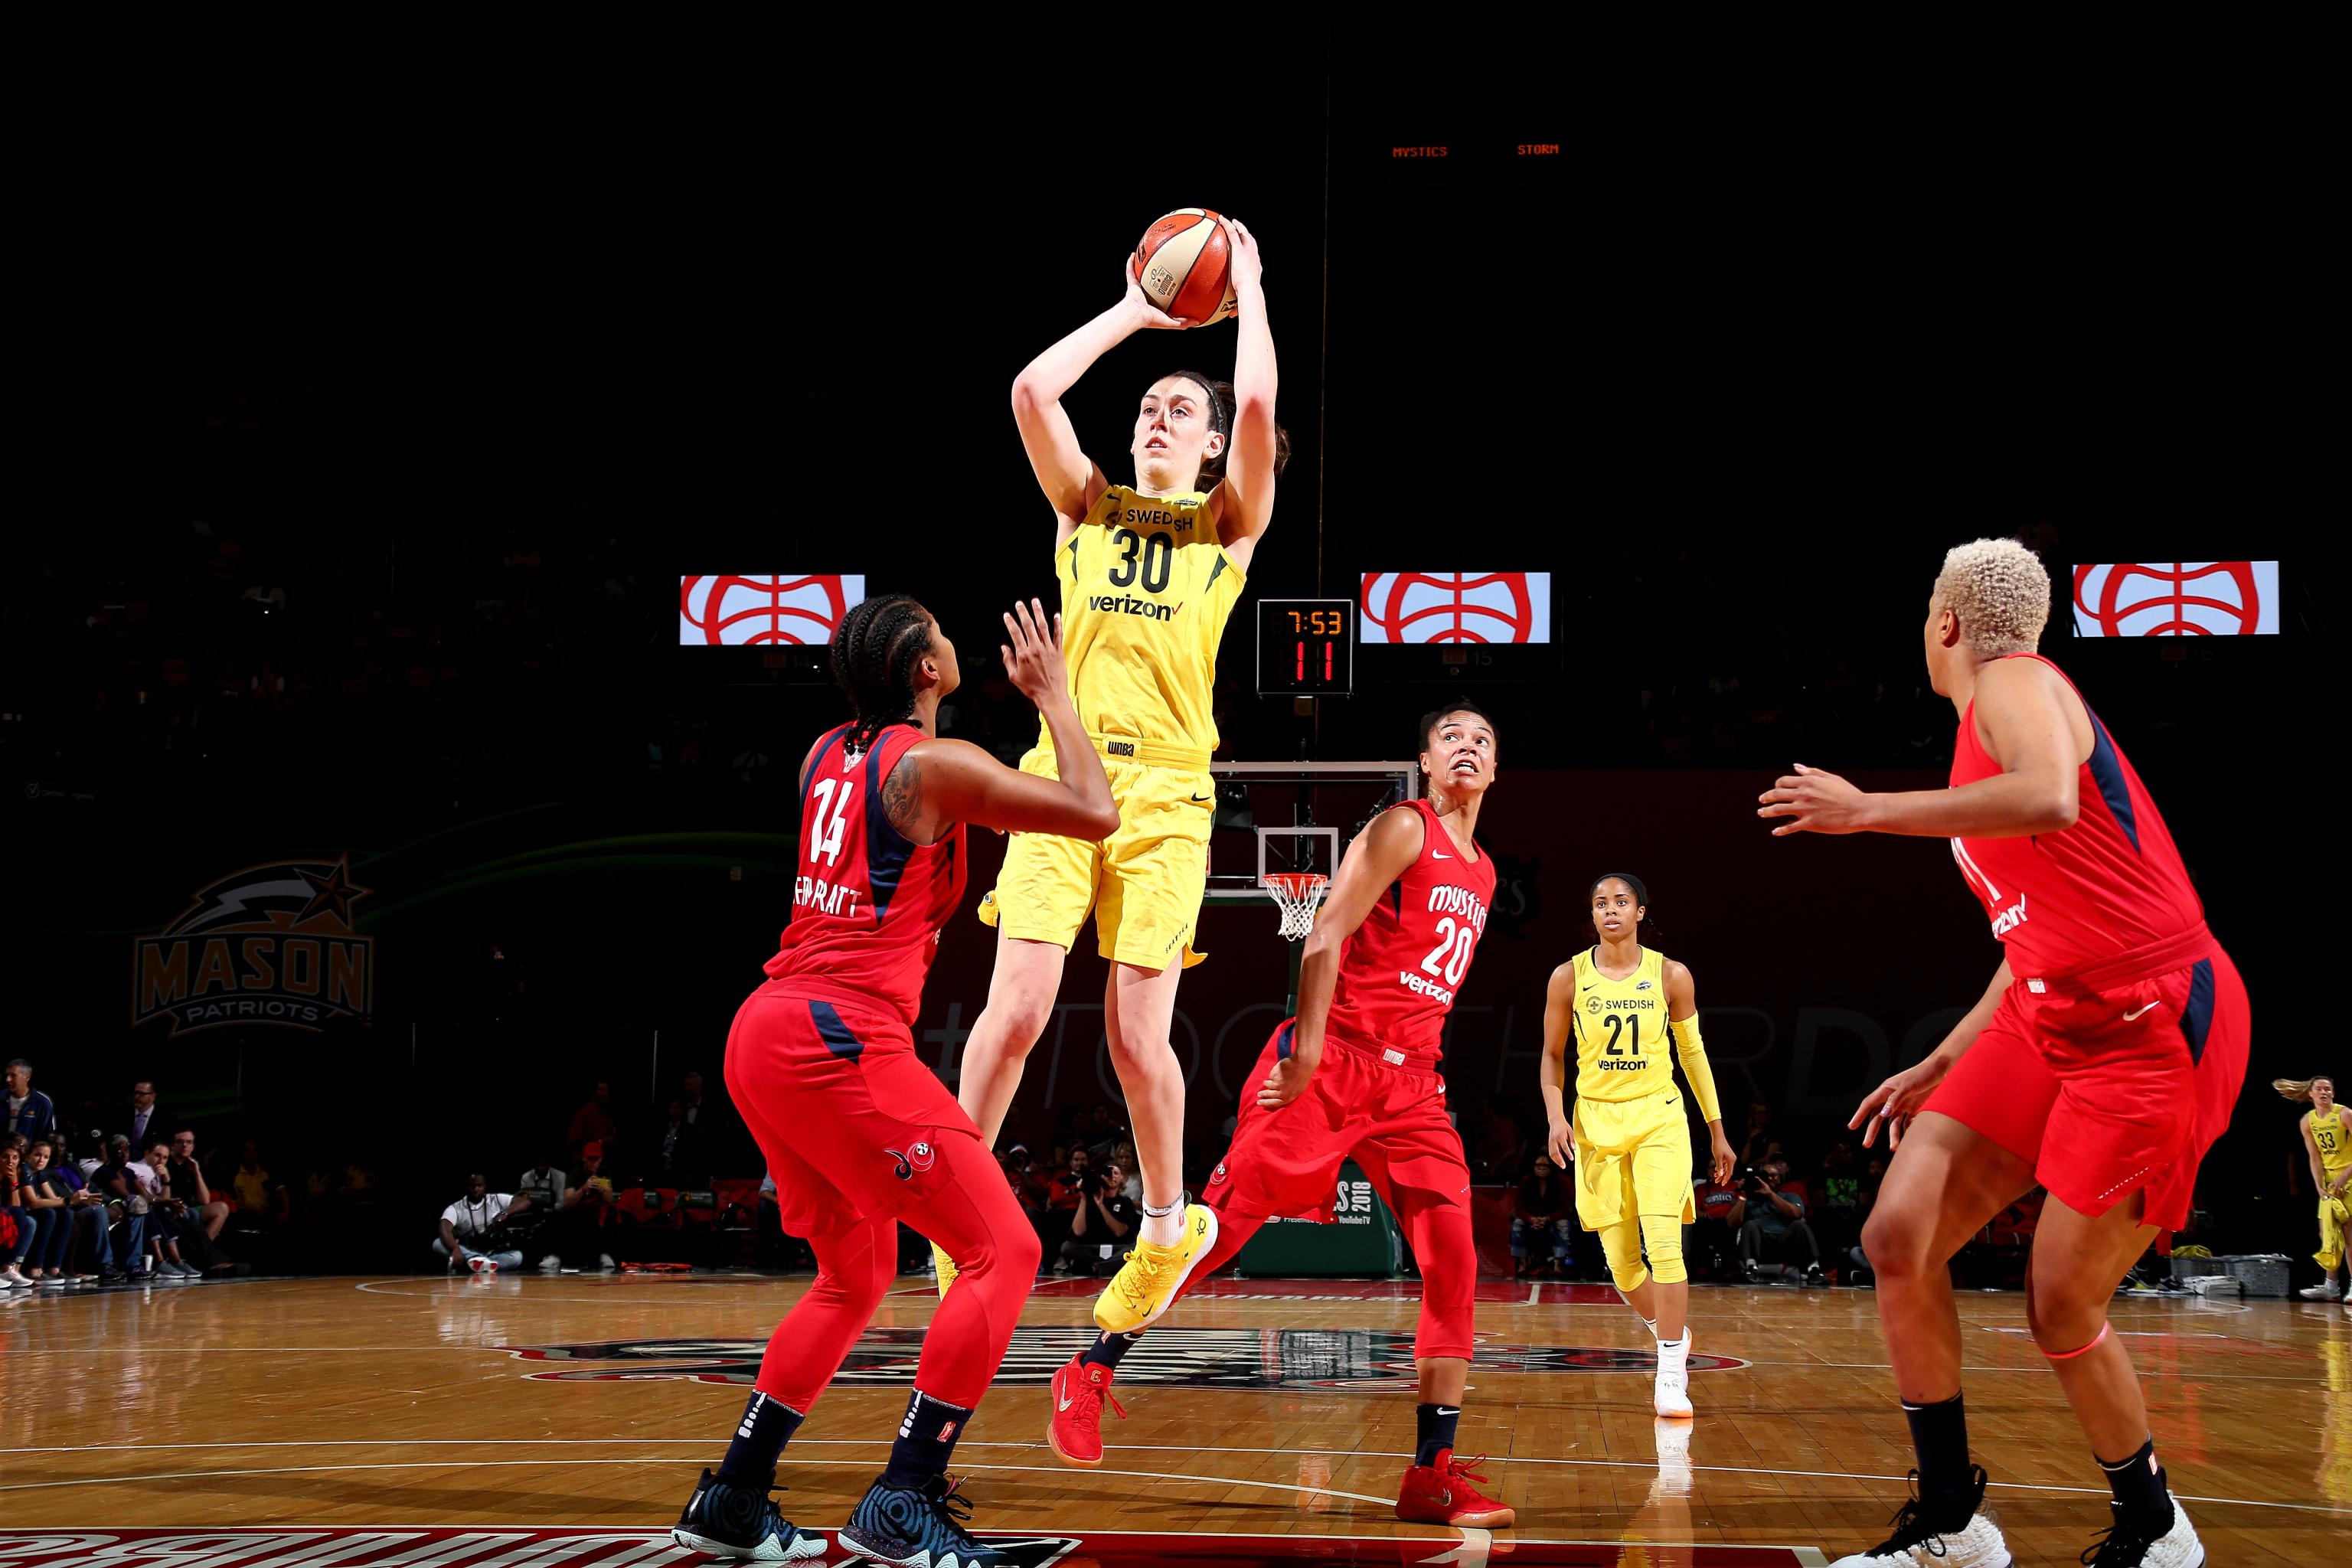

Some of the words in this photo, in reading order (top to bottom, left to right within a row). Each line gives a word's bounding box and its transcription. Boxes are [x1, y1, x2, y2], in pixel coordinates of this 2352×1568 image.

[1392, 146, 1448, 158] MYSTICS
[1517, 144, 1560, 155] STORM
[1108, 528, 1174, 594] 30
[1089, 593, 1172, 622] verizon
[1287, 611, 1342, 635] 7:53
[1295, 641, 1334, 681] 11
[810, 777, 854, 867] 14
[1420, 916, 1473, 987] 20
[139, 936, 367, 1015] MASON
[185, 1000, 320, 1022] PATRIOTS
[1605, 999, 1655, 1010] SWEDISH
[1603, 1014, 1639, 1056] 21
[1597, 1058, 1647, 1071] verizon
[2318, 1131, 2336, 1150] 33
[1351, 1181, 1372, 1213] 2018
